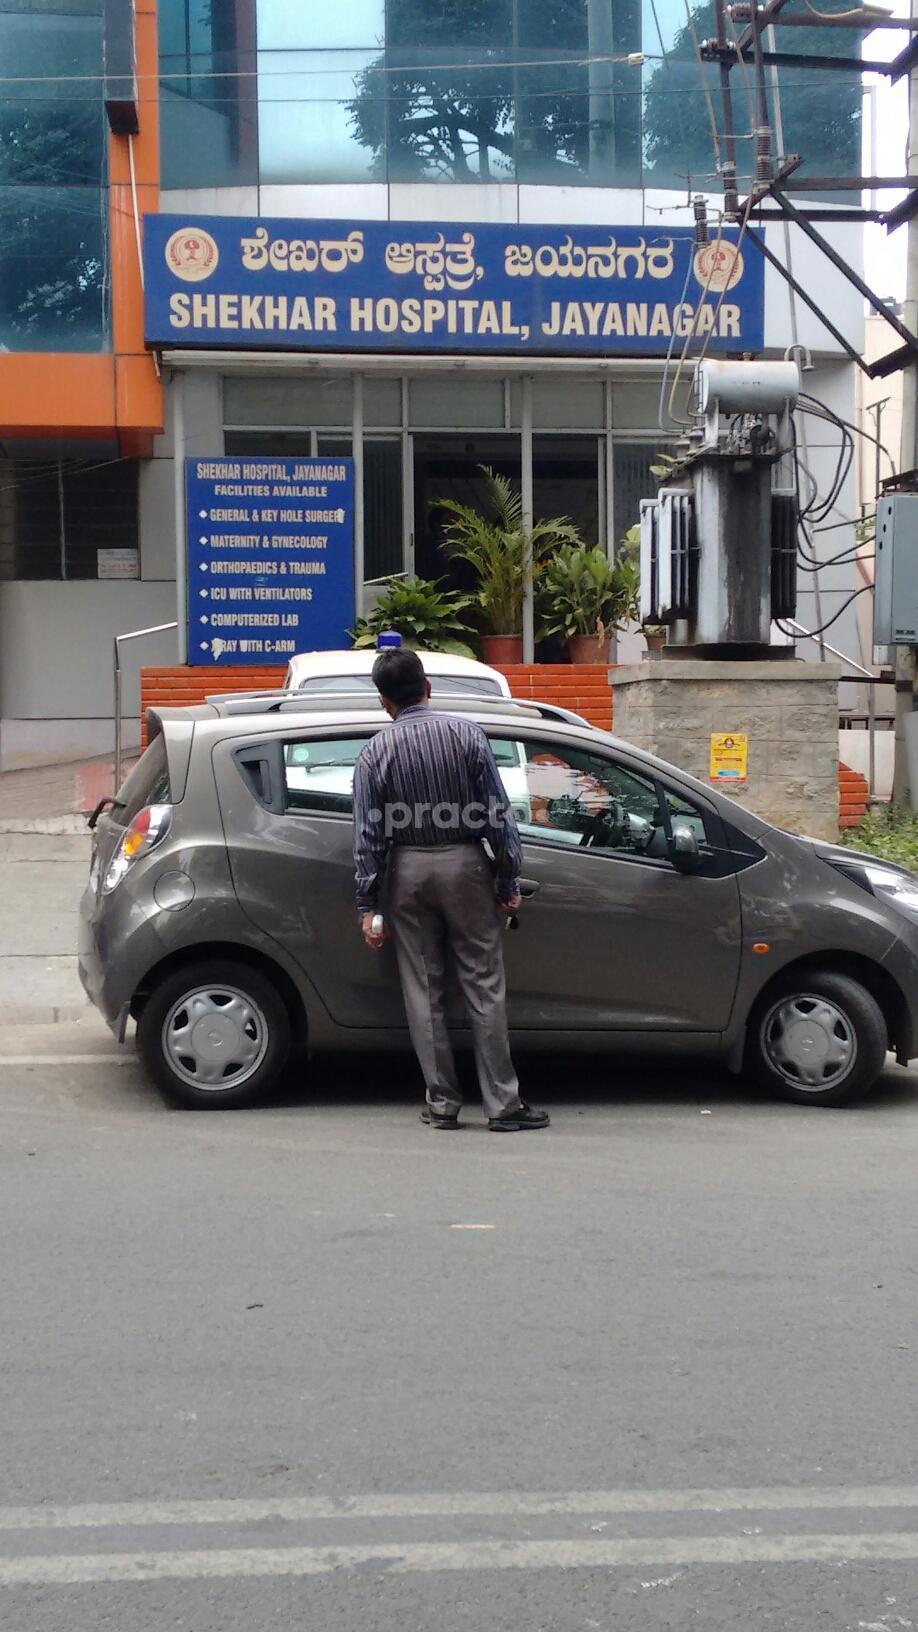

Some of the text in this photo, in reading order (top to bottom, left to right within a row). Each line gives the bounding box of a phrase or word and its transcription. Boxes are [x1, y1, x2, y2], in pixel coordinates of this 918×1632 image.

[240, 227, 364, 272] ಶೇಖರ್
[504, 234, 675, 279] ಜಯನಗರ
[169, 292, 741, 340] SHEKHAR HOSPITAL, JAYANAGAR
[197, 463, 346, 482] SHEKHAR HOSPITAL, JAYANAGAR
[214, 484, 328, 498] FACILITIES AVAILABLE
[210, 508, 250, 522] GENERAL
[252, 509, 259, 522] &
[261, 509, 278, 522] KEY
[280, 509, 303, 522] HOLE
[210, 535, 328, 549] MATERNITY & GYNECOLOGY
[210, 561, 326, 575] ORTHOPAEDICS & TRAUMA
[210, 587, 313, 601] ICU WITH VENTILATORS
[210, 613, 299, 627] COMPUTERIZED LAB
[239, 639, 263, 653] WITH
[264, 639, 296, 653] C-ARM
